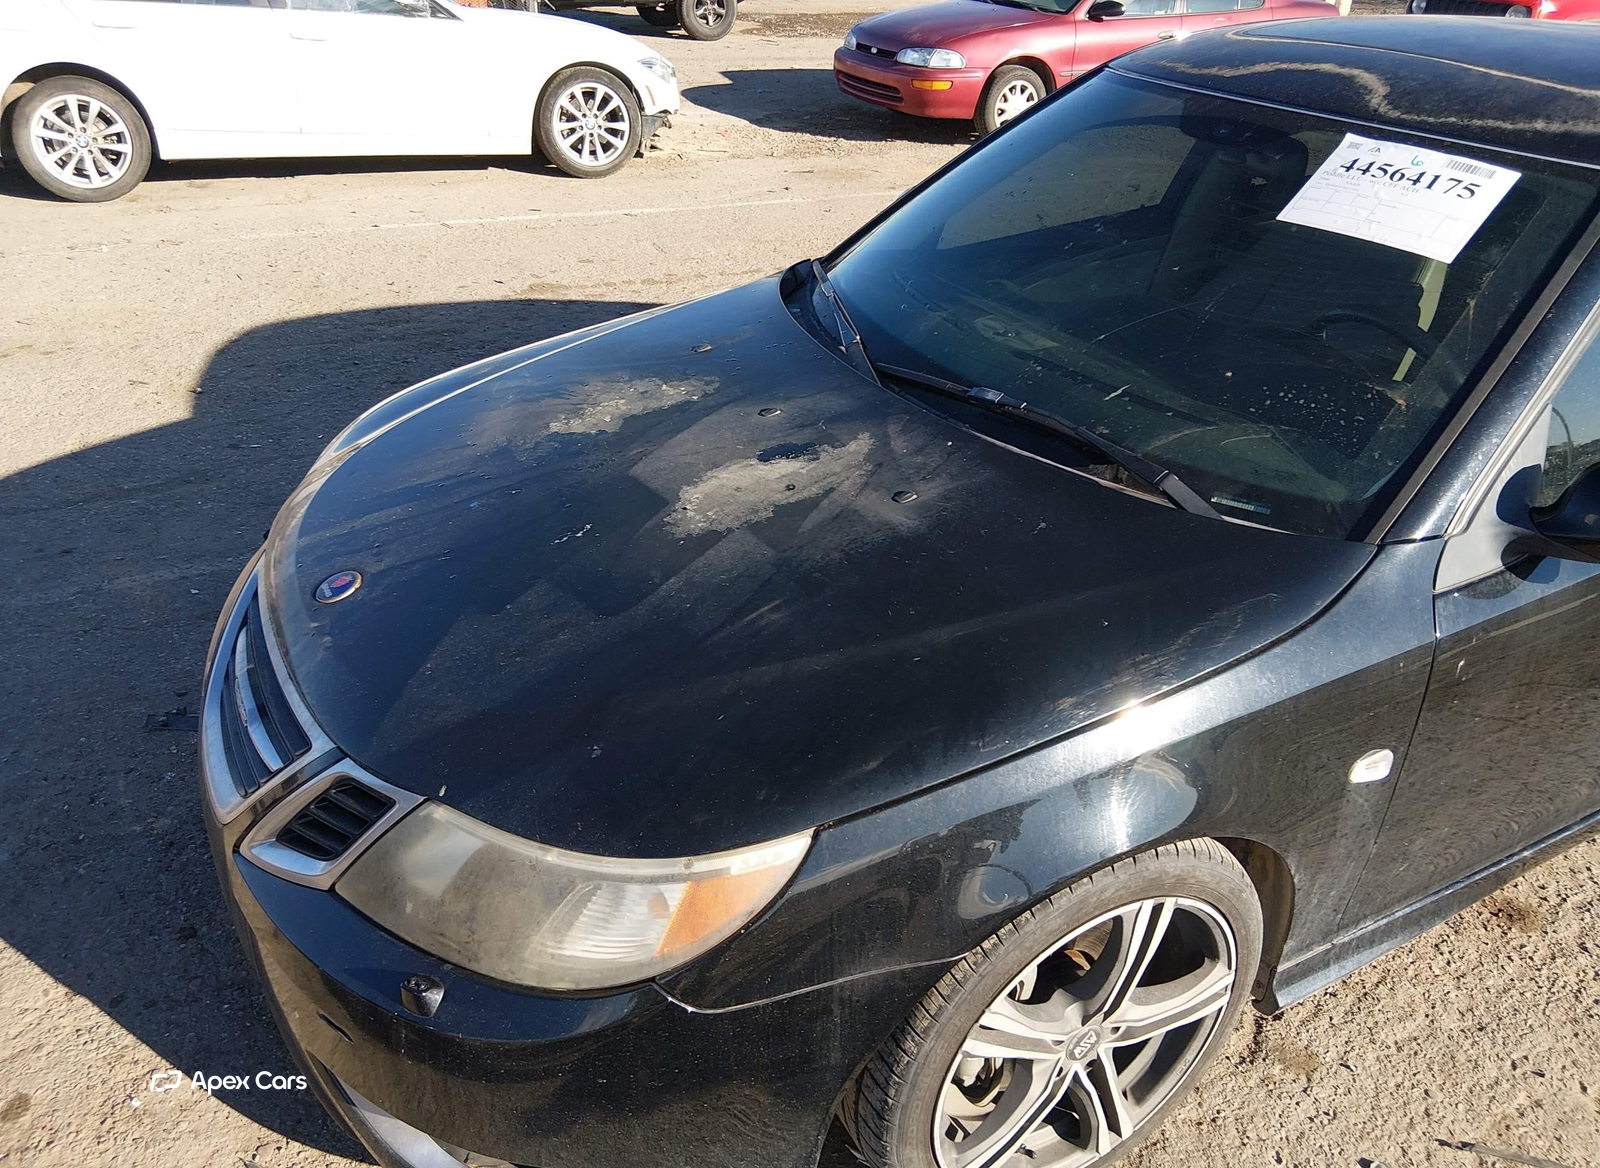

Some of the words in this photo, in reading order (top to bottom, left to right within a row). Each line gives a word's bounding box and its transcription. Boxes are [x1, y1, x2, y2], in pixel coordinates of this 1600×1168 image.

[1322, 169, 1346, 179] Peddle
[1346, 173, 1363, 182] LLC
[1339, 157, 1483, 199] 44564175
